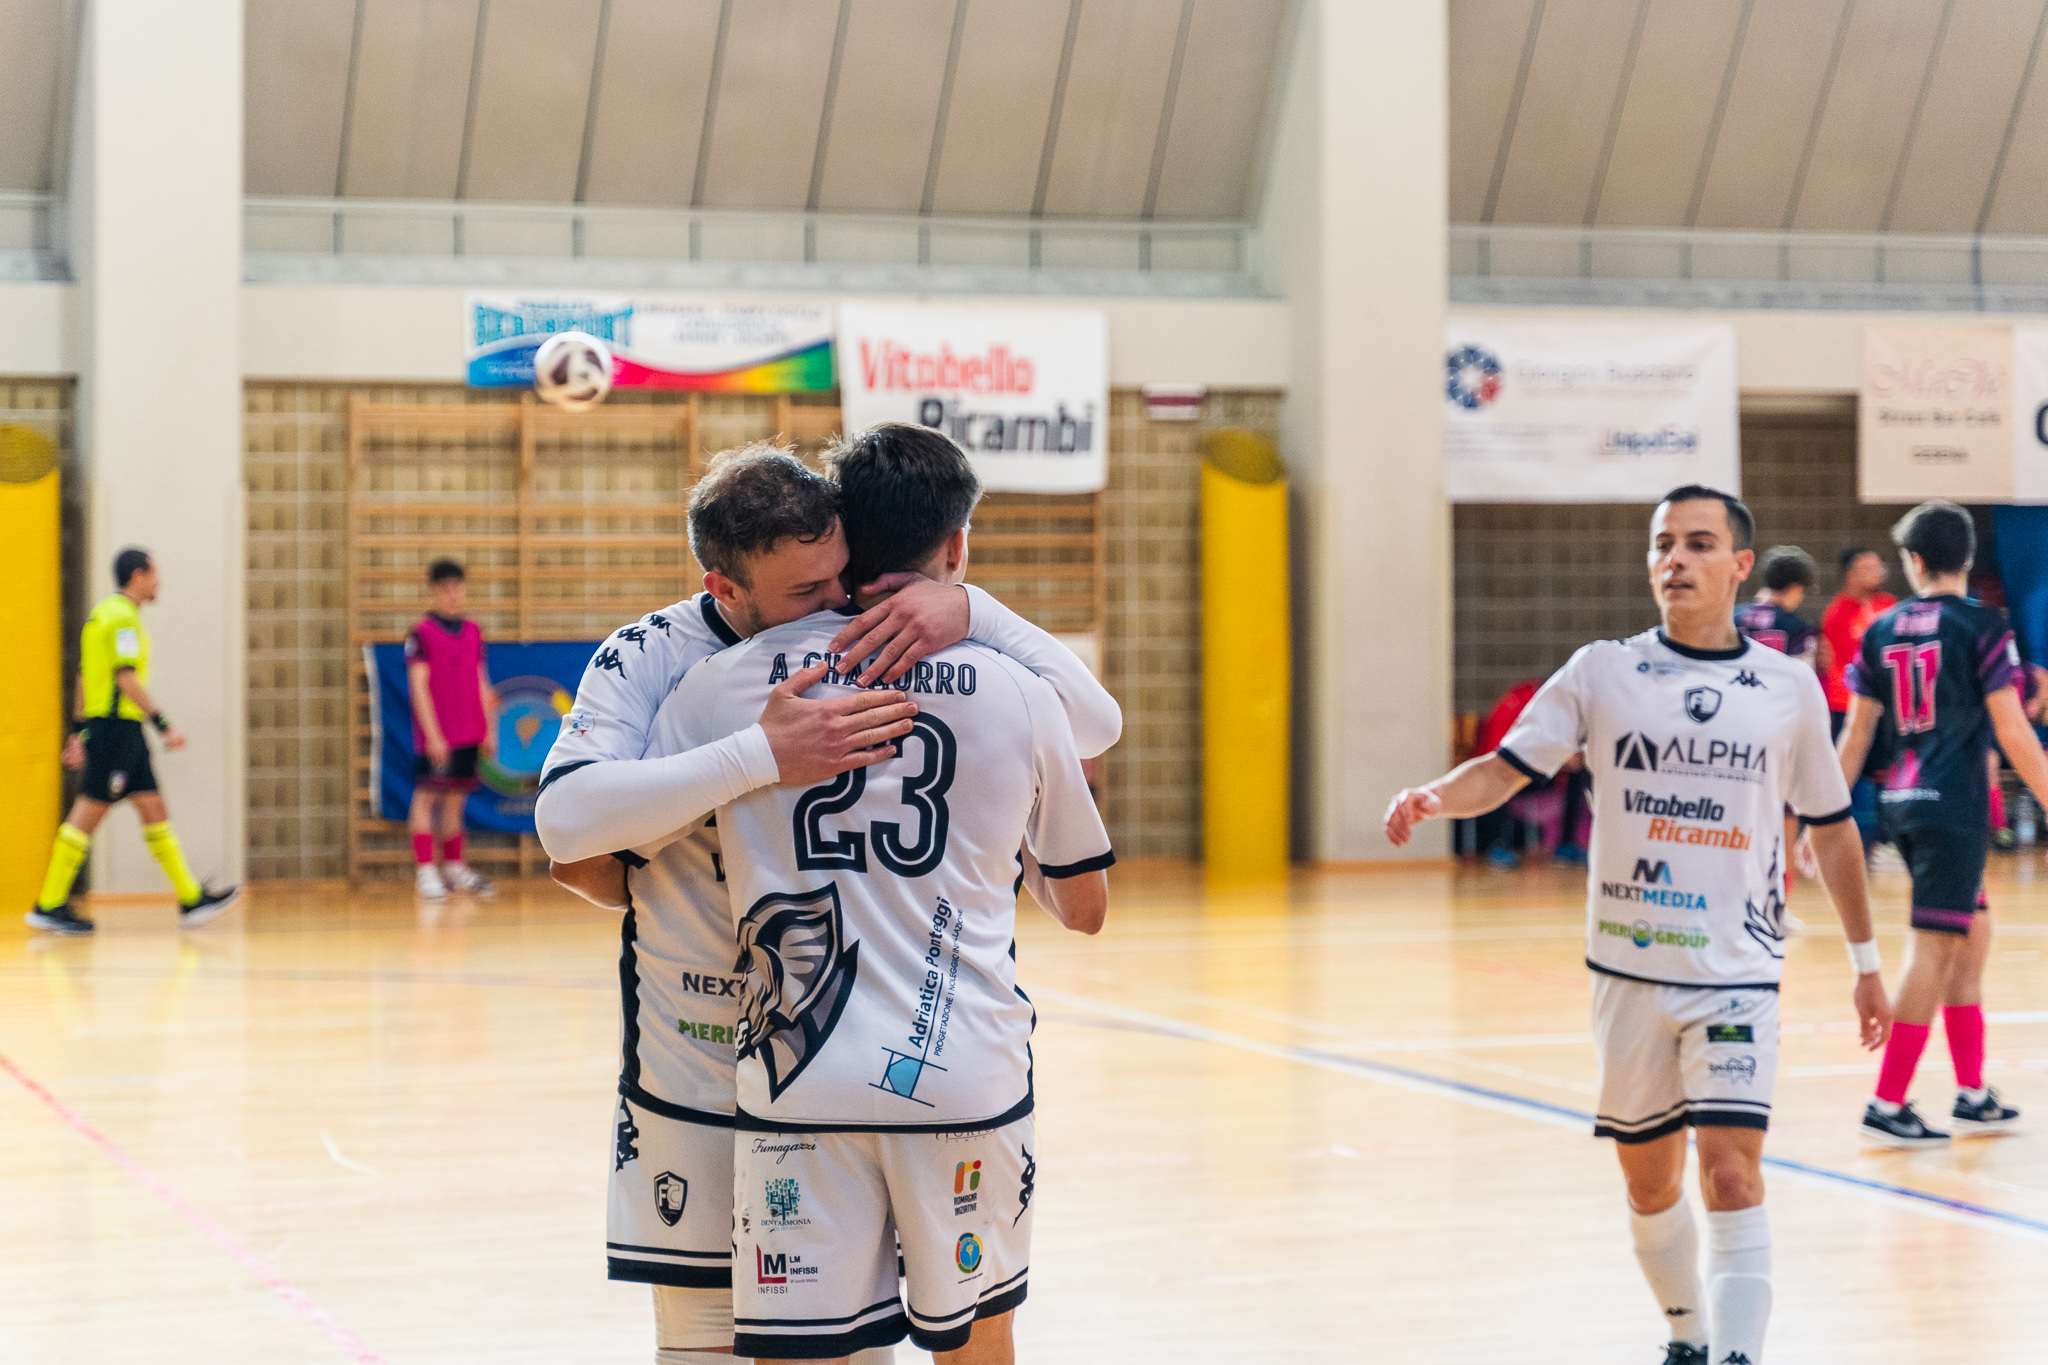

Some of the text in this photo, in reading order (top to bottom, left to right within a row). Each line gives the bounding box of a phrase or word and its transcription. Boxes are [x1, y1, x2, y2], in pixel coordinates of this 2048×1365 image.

[859, 338, 1036, 392] Vitobello
[769, 653, 788, 684] A
[1881, 640, 1942, 736] 11
[1662, 736, 1767, 773] ALPHA
[793, 711, 957, 878] 23
[1624, 788, 1725, 822] Vitobello
[1648, 817, 1753, 850] Ricambi
[1601, 881, 1707, 911] NEXTMEDIA
[682, 972, 742, 998] NEX
[908, 896, 952, 1049] Adriatica Ponteggi
[678, 1019, 733, 1044] PIERI
[789, 1255, 801, 1264] LM
[789, 1266, 818, 1275] INFISSI
[757, 1285, 788, 1294] INFISSI
